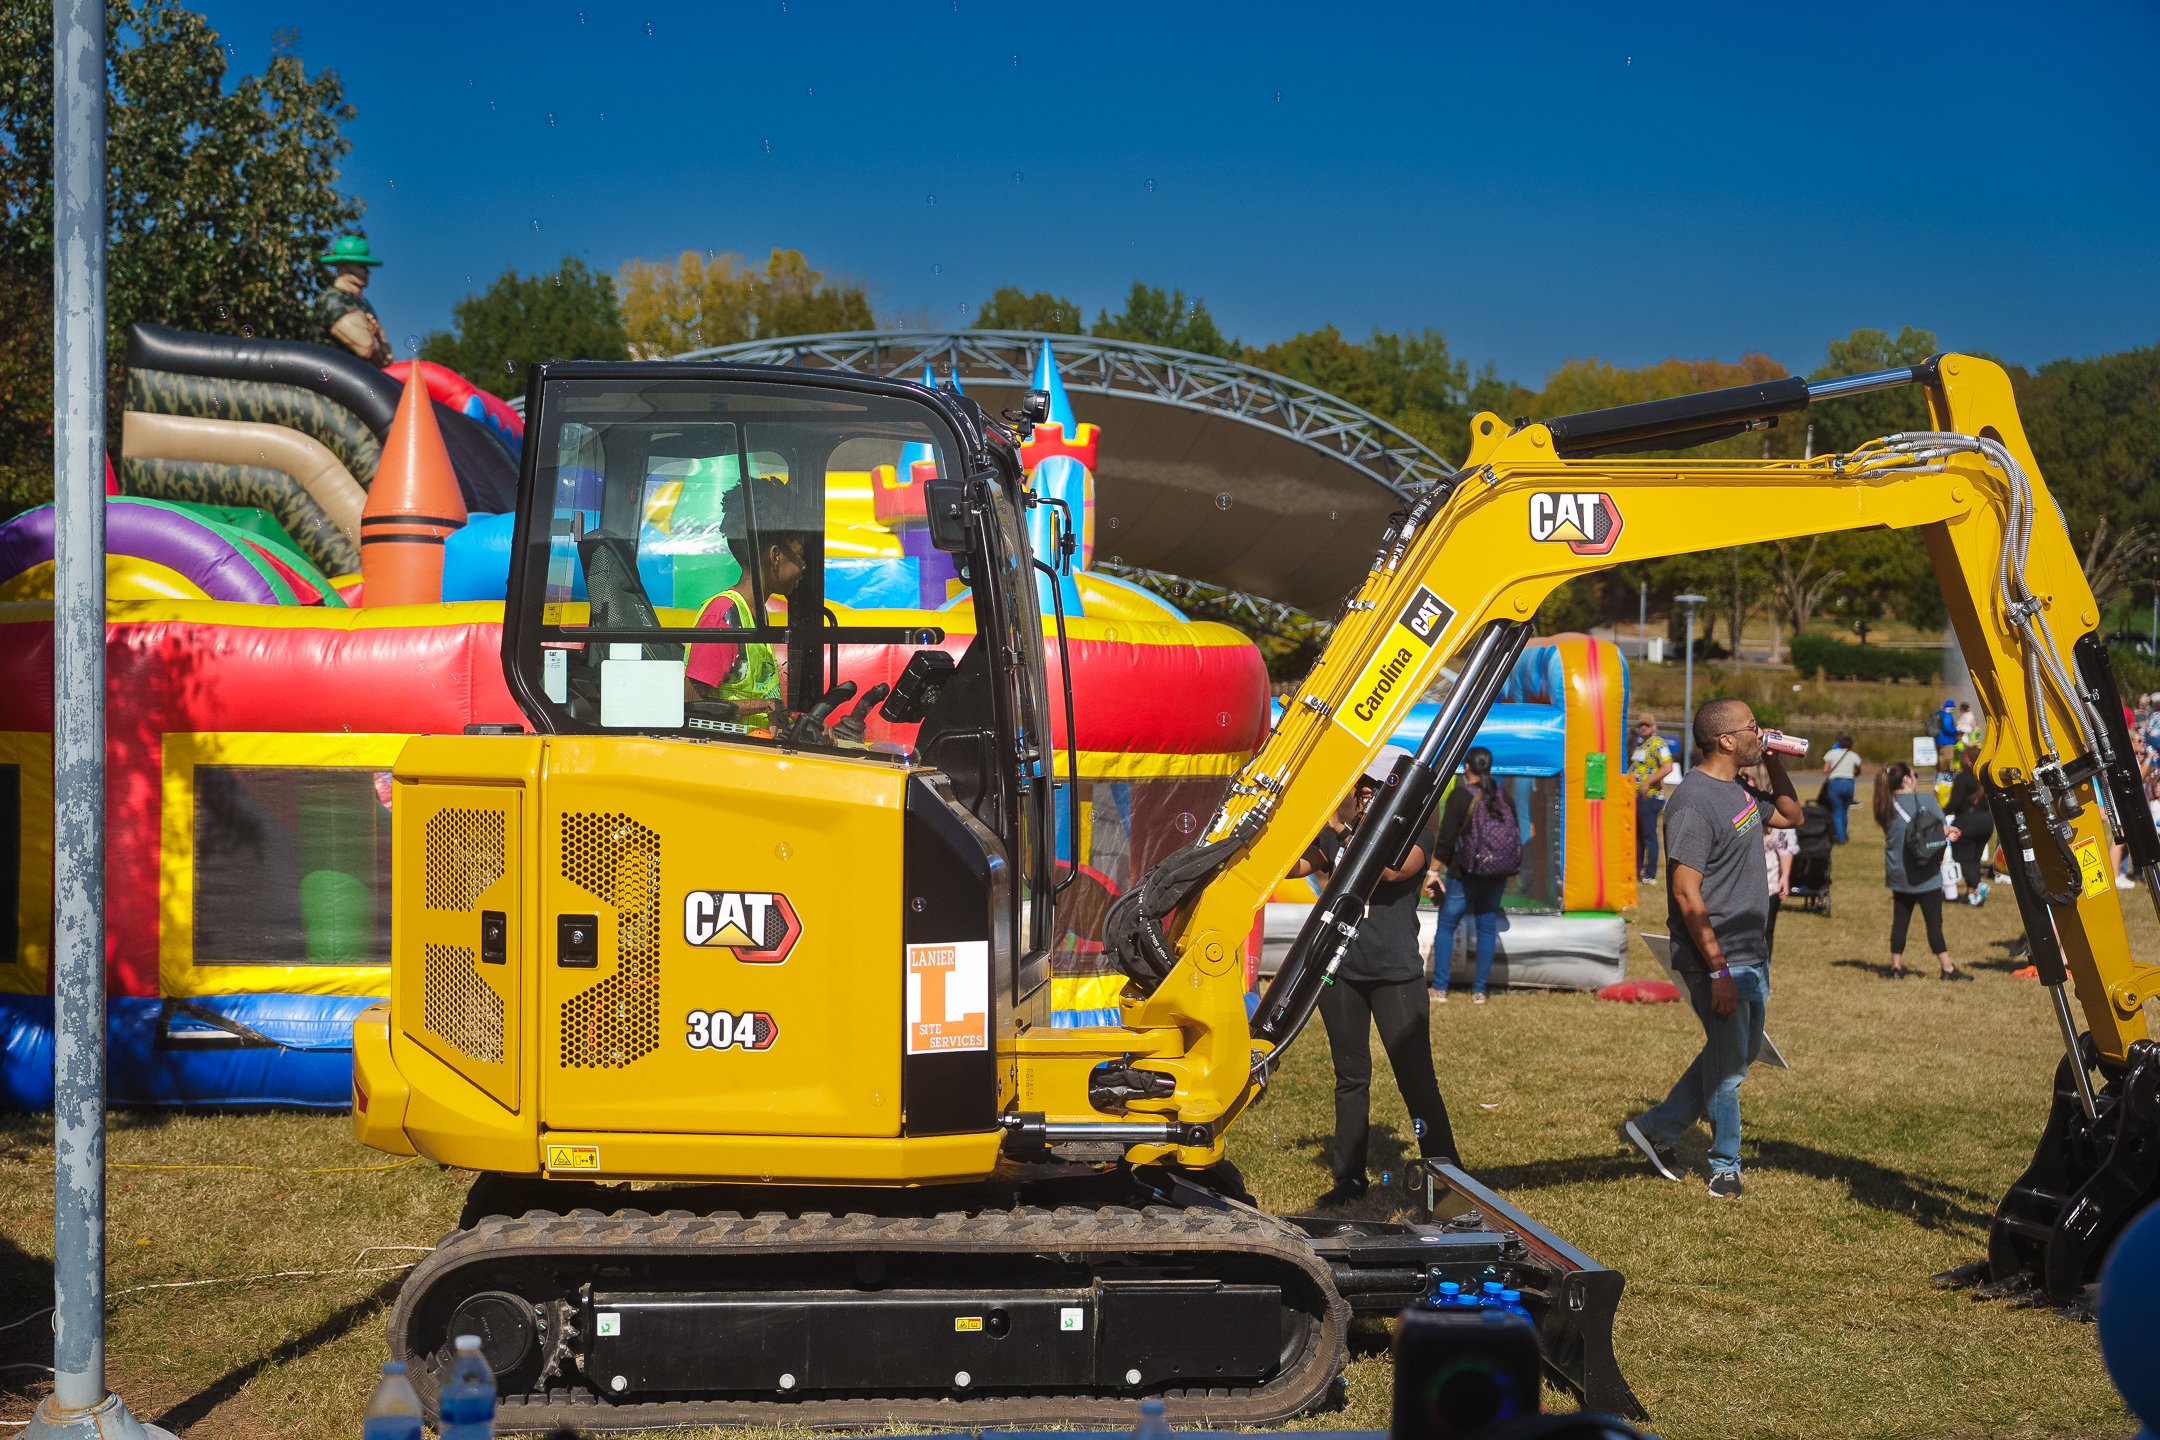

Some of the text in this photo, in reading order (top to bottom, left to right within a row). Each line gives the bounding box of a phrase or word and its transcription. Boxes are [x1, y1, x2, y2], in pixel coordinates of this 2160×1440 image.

[1530, 493, 1600, 541] CAT
[1411, 595, 1442, 636] CAT
[1354, 648, 1413, 722] Carolina
[685, 891, 773, 947] CAT
[911, 950, 955, 967] LANIER
[688, 1011, 756, 1048] 304
[919, 1023, 942, 1035] SITE
[929, 1034, 983, 1048] SERVICES
